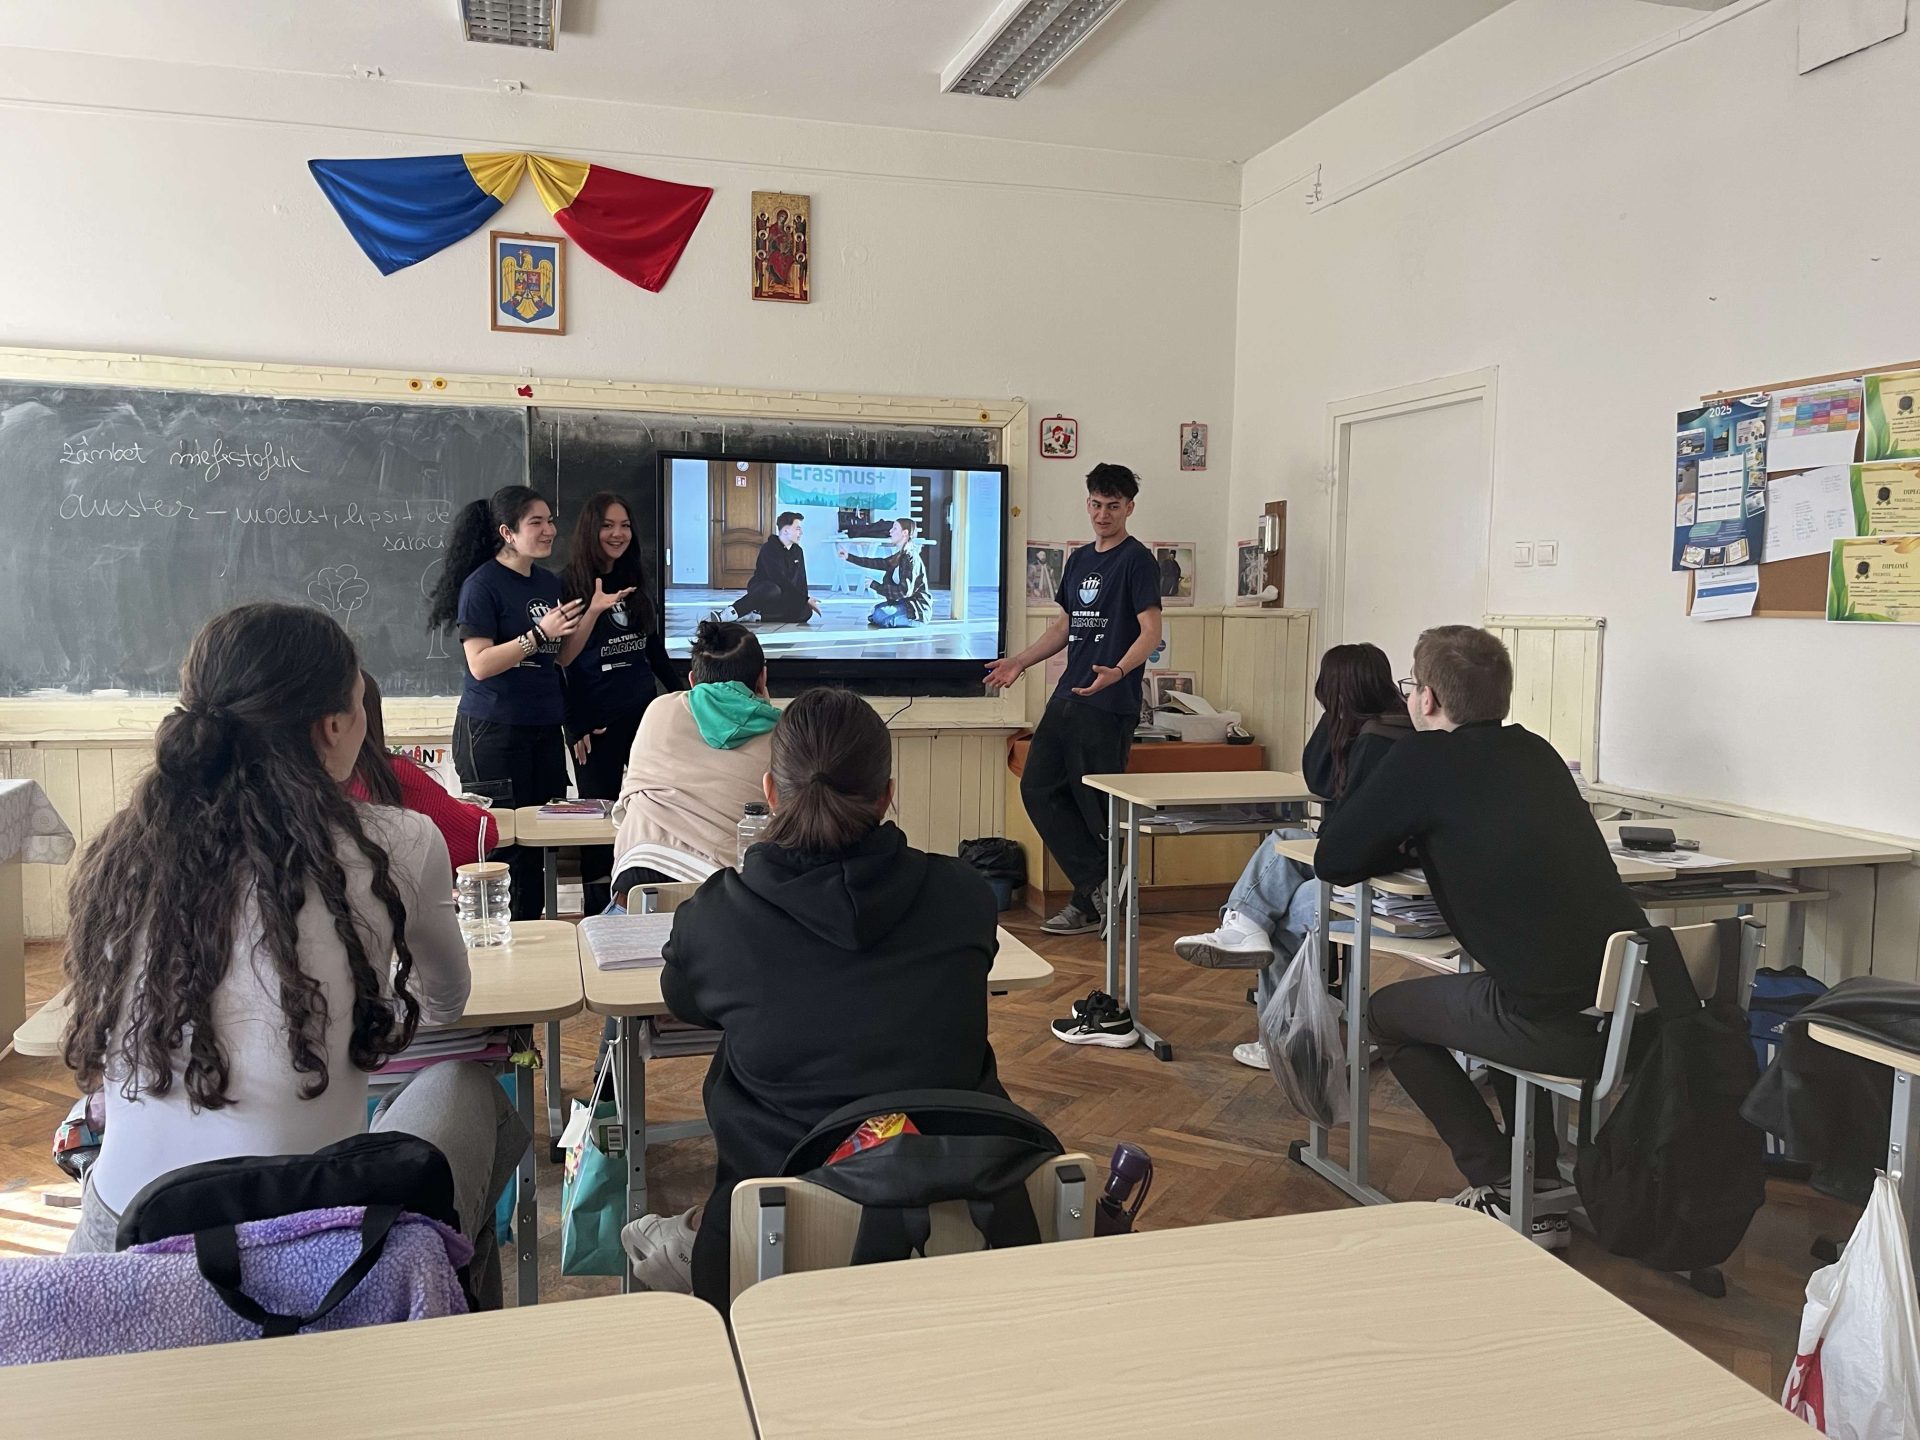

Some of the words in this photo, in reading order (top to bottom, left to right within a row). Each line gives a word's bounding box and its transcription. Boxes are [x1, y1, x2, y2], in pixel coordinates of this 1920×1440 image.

[1708, 405, 1732, 418] 2025
[790, 464, 886, 485] Erasmus+
[600, 637, 647, 657] HARMO
